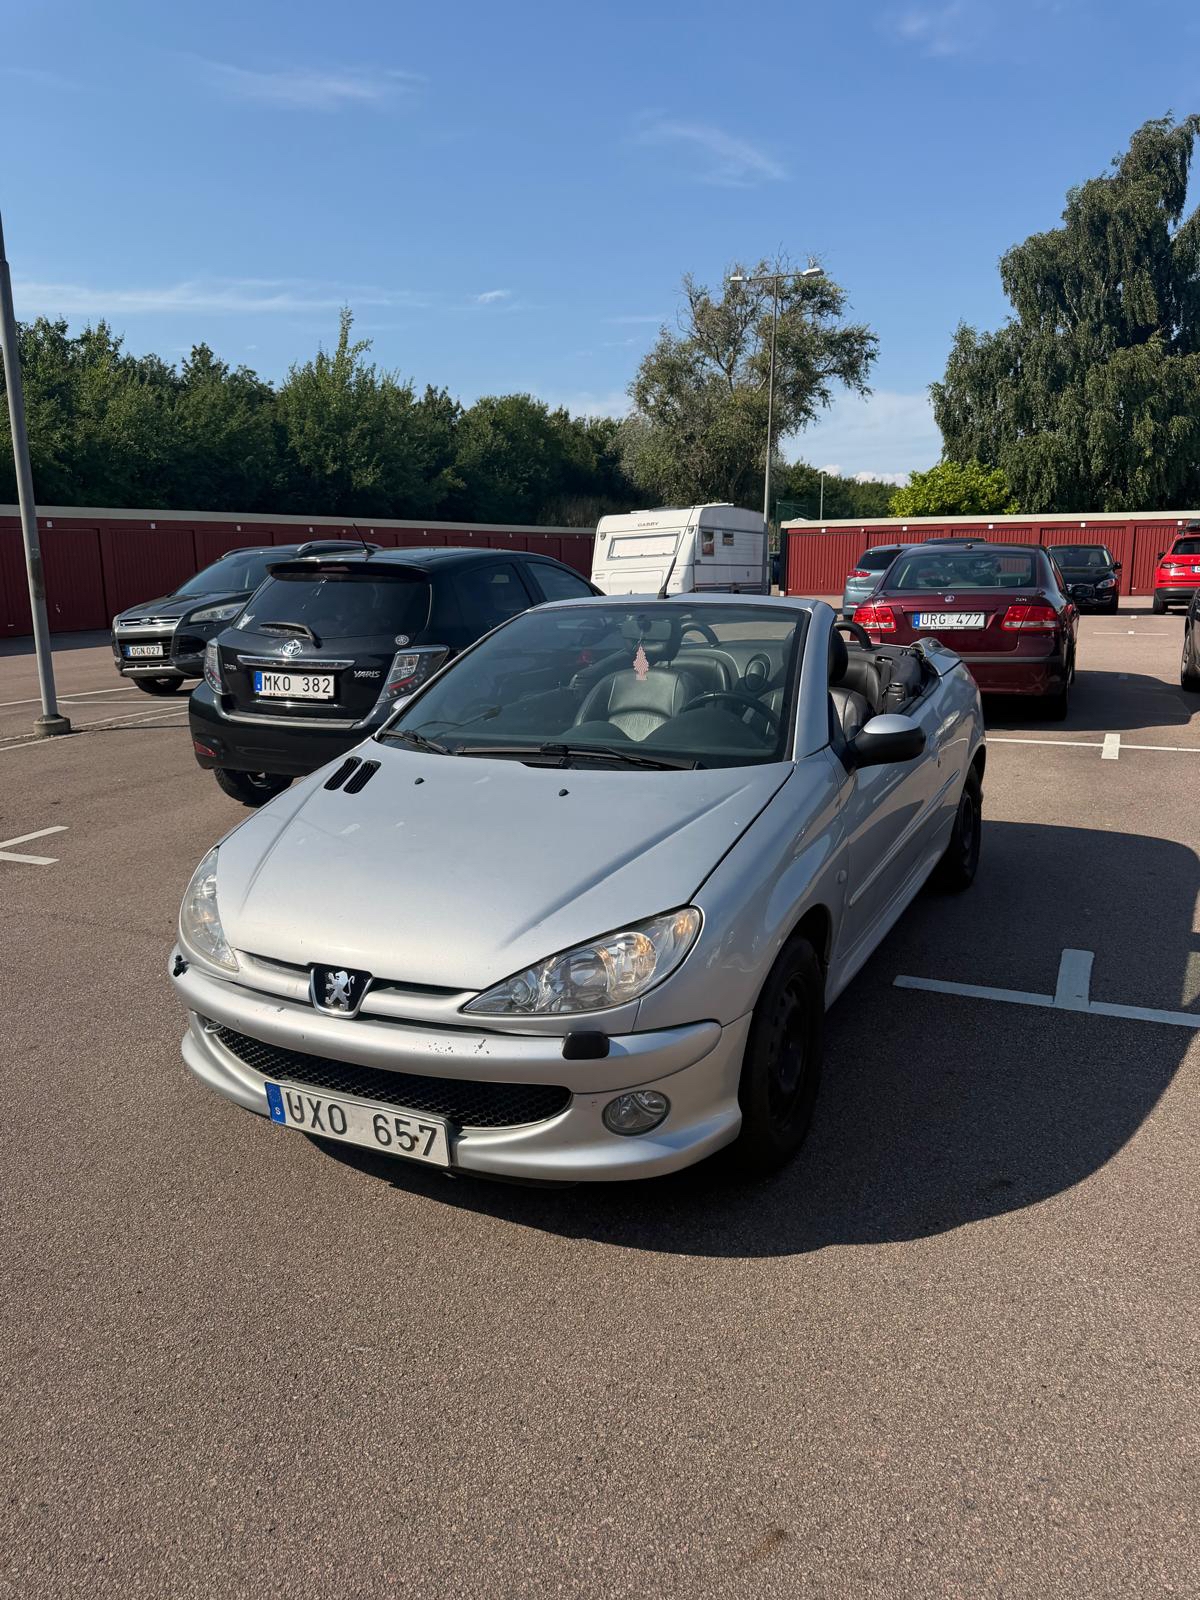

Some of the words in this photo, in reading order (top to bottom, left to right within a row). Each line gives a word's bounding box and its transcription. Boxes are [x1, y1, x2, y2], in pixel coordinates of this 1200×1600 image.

[921, 613, 946, 625] URG
[956, 613, 982, 625] 477
[146, 646, 160, 655] 027
[353, 670, 381, 678] YARIS
[264, 675, 291, 691] MKO
[302, 677, 331, 694] 382
[274, 1106, 281, 1115] S
[285, 1091, 348, 1135] UXO
[372, 1113, 438, 1157] 657
